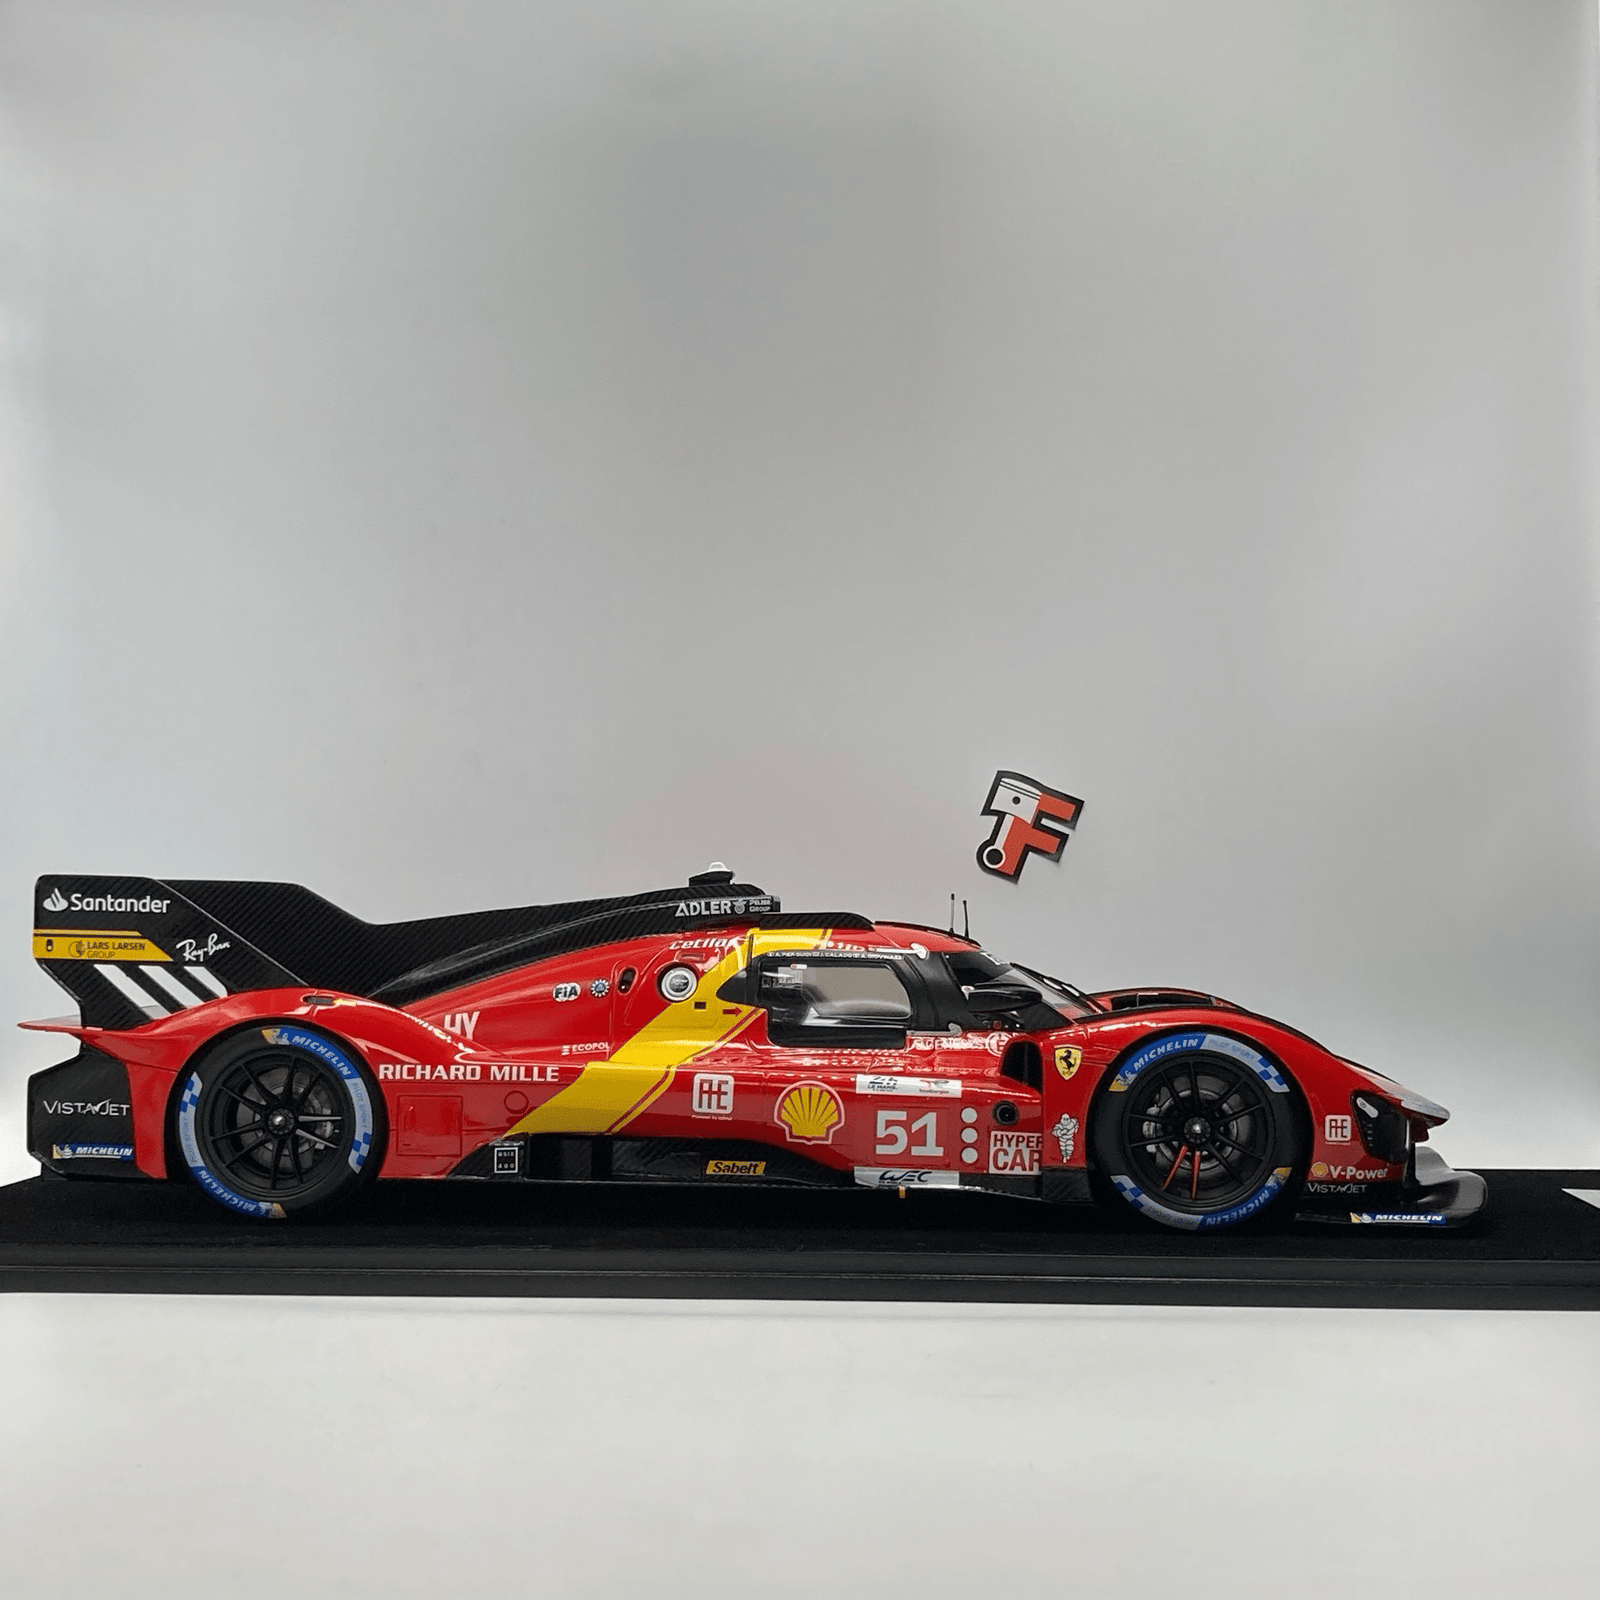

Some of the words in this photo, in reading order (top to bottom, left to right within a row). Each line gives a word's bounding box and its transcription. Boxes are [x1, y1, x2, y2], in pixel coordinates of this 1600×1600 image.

[70, 893, 171, 914] Santander
[675, 900, 732, 917] ADLER
[87, 941, 110, 950] LARS
[112, 942, 146, 951] LARSEN
[87, 951, 116, 959] GROUP
[176, 933, 231, 962] Ray-Ban
[292, 1034, 352, 1077] MICHELIN
[572, 1042, 610, 1052] ECOPOL
[1133, 1038, 1199, 1072] MICHELIN
[378, 1064, 482, 1081] RICHARD
[489, 1065, 559, 1082] MILLE
[875, 1110, 944, 1157] 51
[75, 1147, 133, 1156] MICHELIN
[993, 1148, 1041, 1171] CAR
[712, 1162, 758, 1174] Sabelt
[879, 1170, 932, 1183] WEC
[1329, 1165, 1388, 1179] V-Power
[198, 1168, 258, 1212] MICHELIN
[1205, 1189, 1271, 1226] MICHELIN
